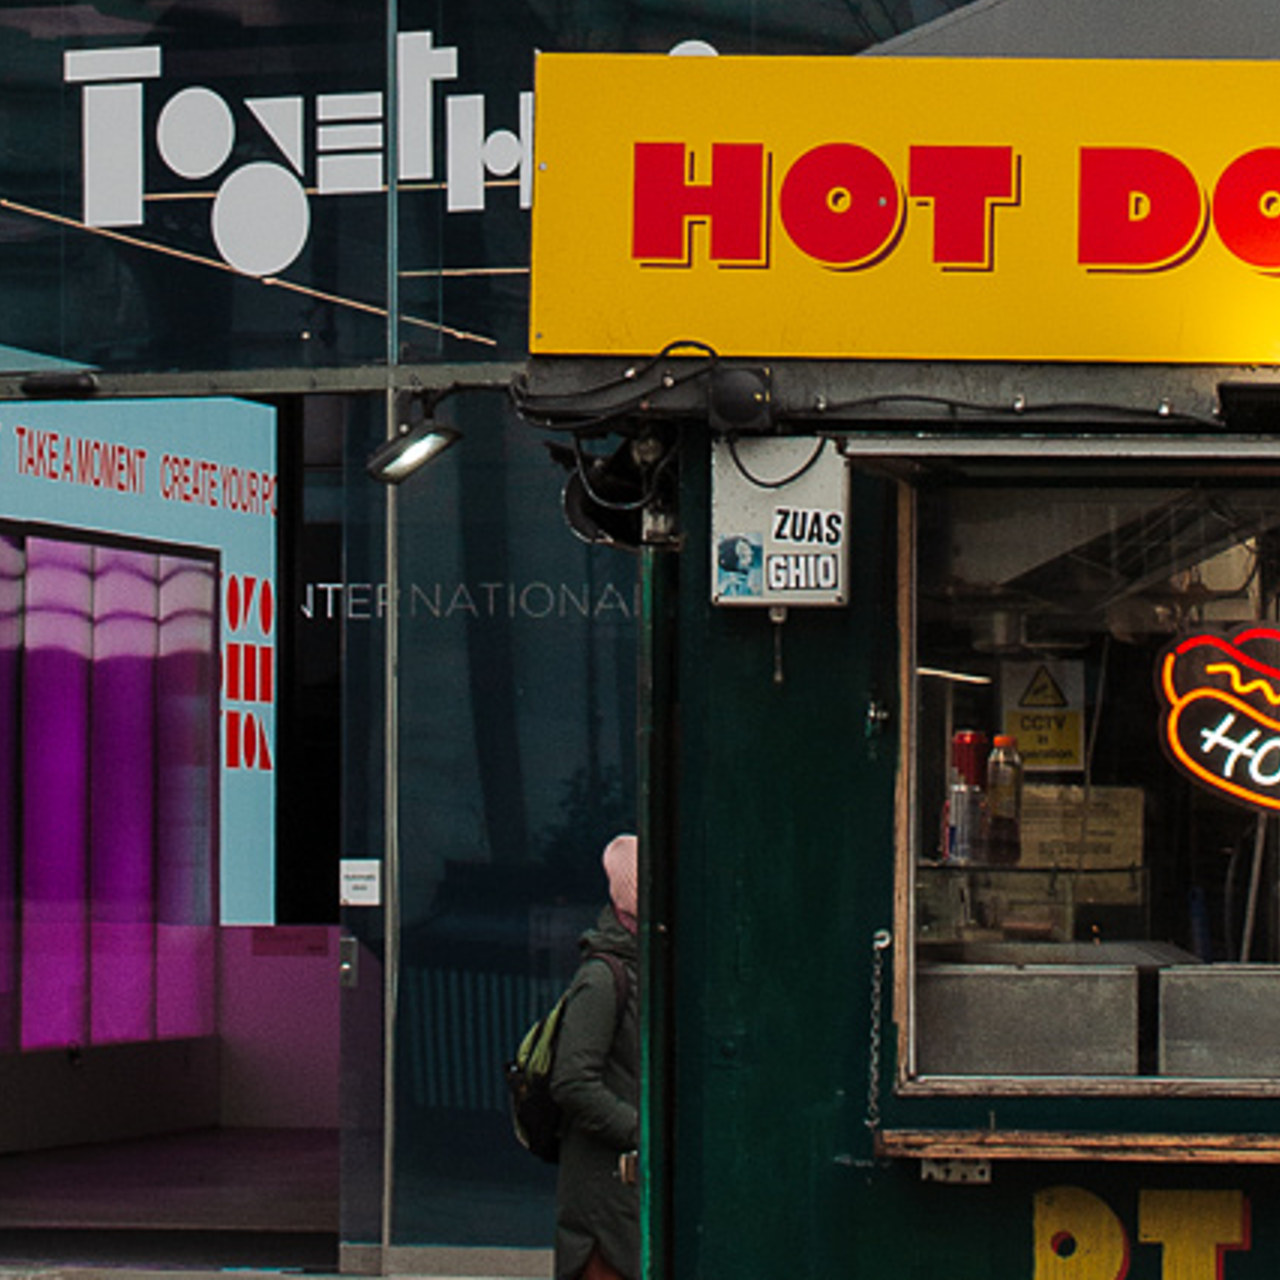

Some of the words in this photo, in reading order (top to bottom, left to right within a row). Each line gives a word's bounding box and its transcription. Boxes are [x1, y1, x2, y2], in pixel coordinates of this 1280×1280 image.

[632, 142, 1020, 272] HOT
[16, 426, 59, 483] TAKE
[62, 440, 74, 483] A
[76, 444, 147, 494] MOMENT
[160, 454, 219, 508] CREATE
[221, 467, 259, 516] YOUR
[774, 507, 843, 547] ZUAS
[1021, 714, 1067, 731] CCTV
